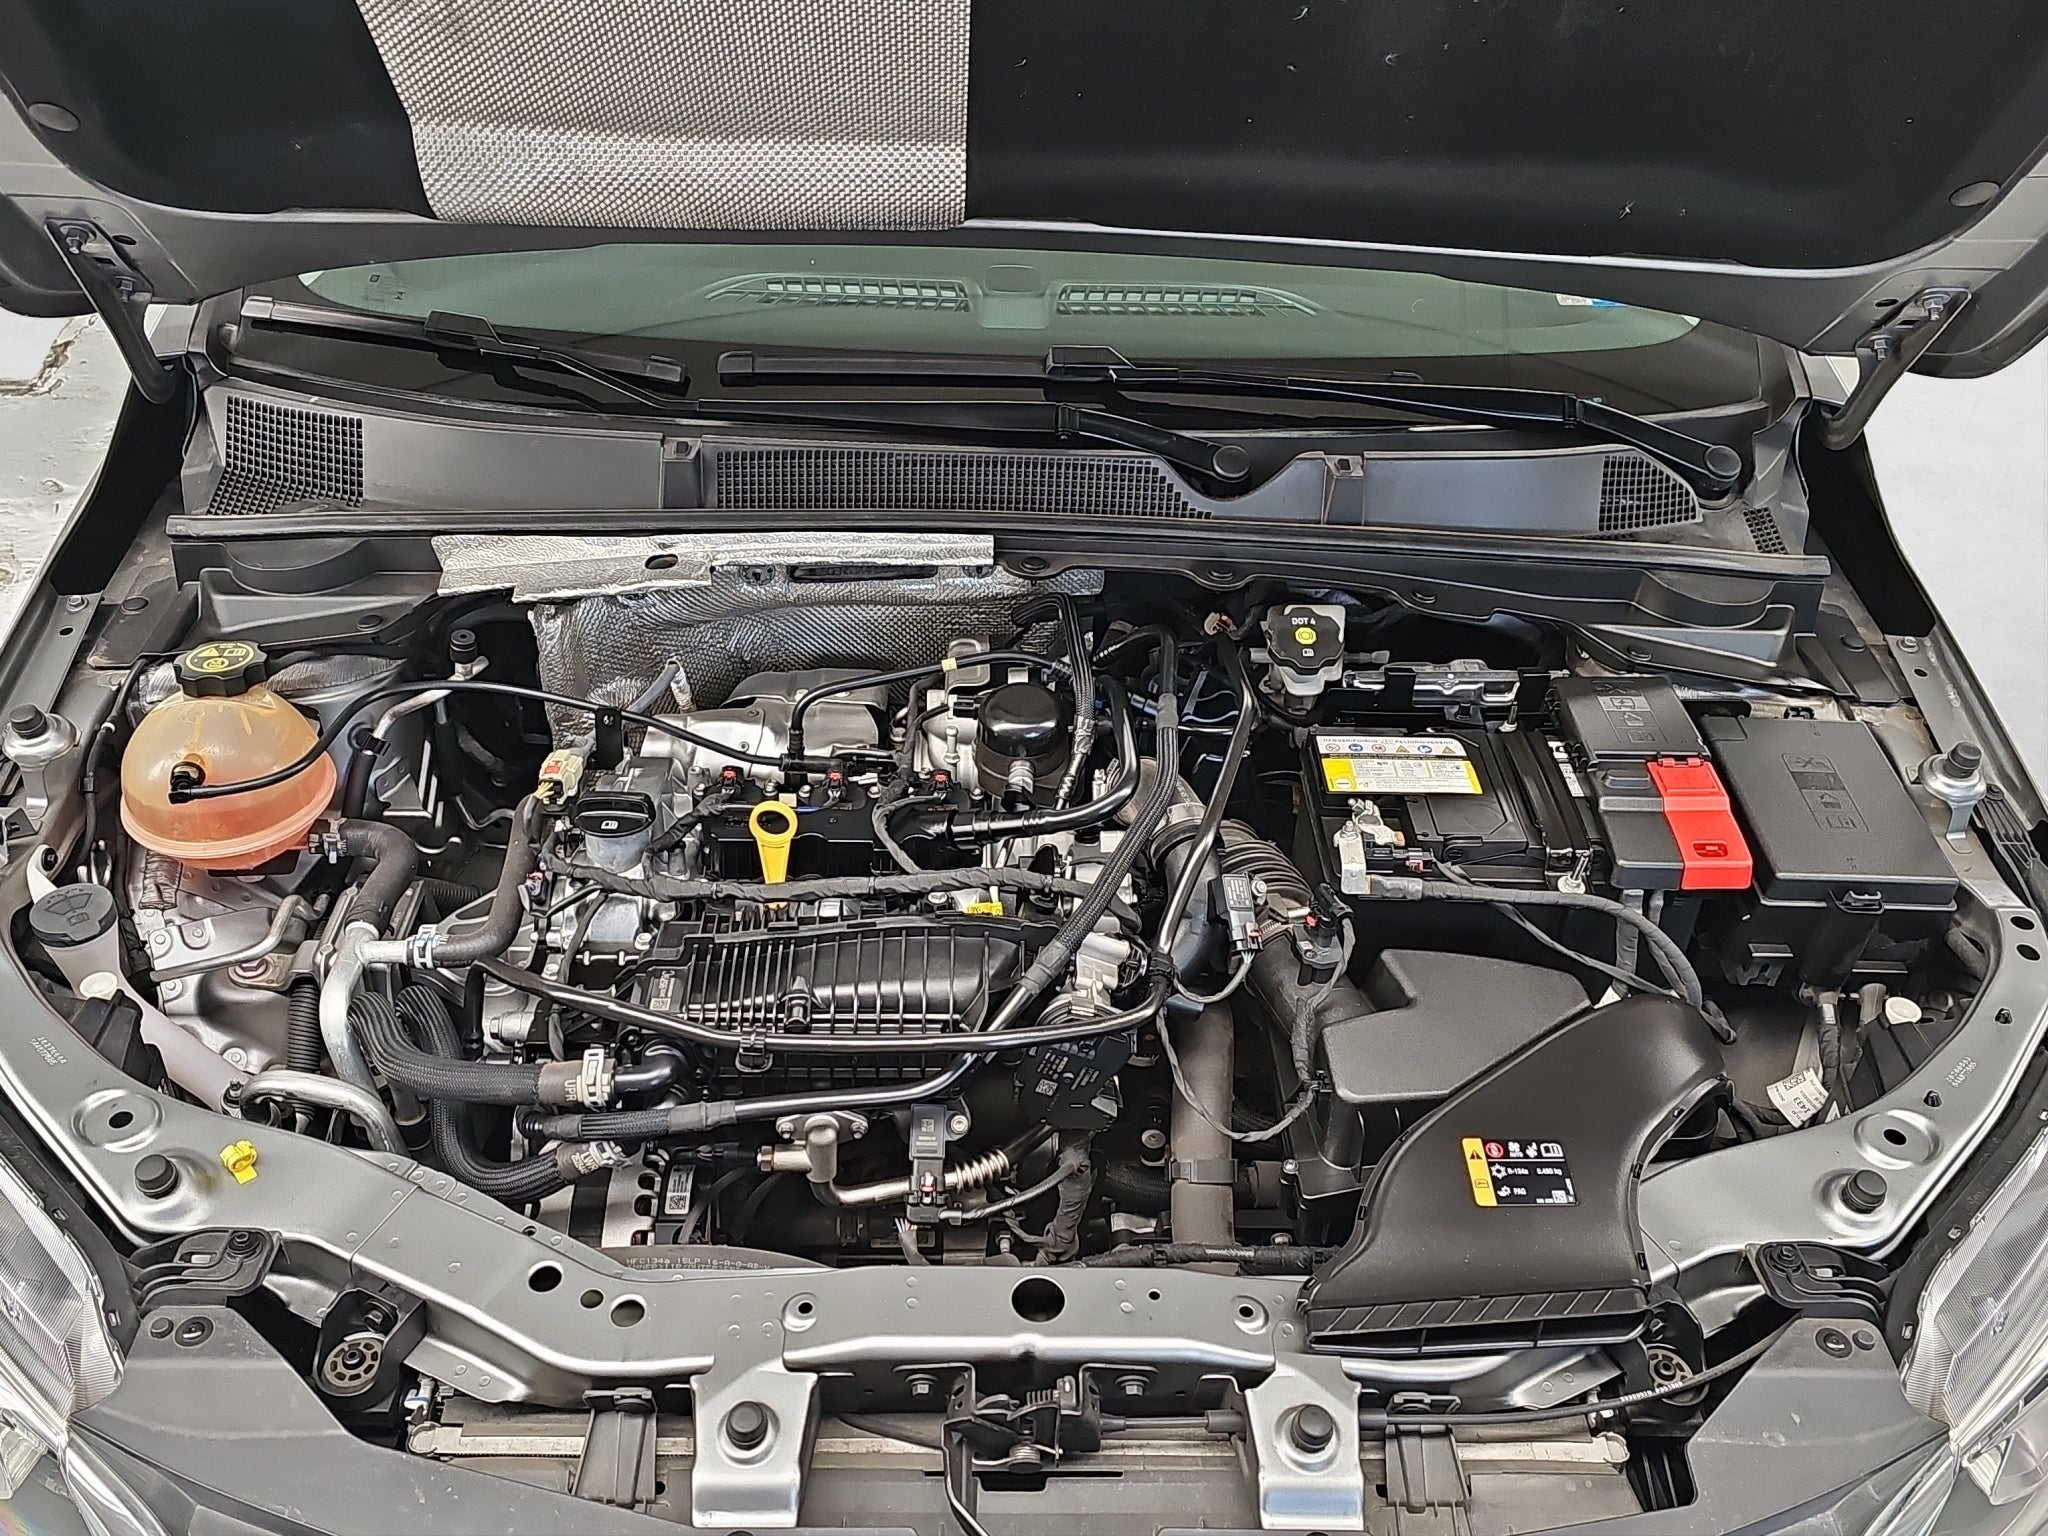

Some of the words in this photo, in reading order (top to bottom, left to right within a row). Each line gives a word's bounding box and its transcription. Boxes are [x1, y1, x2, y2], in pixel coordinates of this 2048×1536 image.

[1291, 617, 1309, 625] DOT
[1310, 617, 1316, 625] 4
[564, 1079, 577, 1102] UPR
[1793, 1096, 1811, 1114] 1433
[580, 1151, 600, 1172] LWR
[626, 1257, 671, 1265] HFC134a
